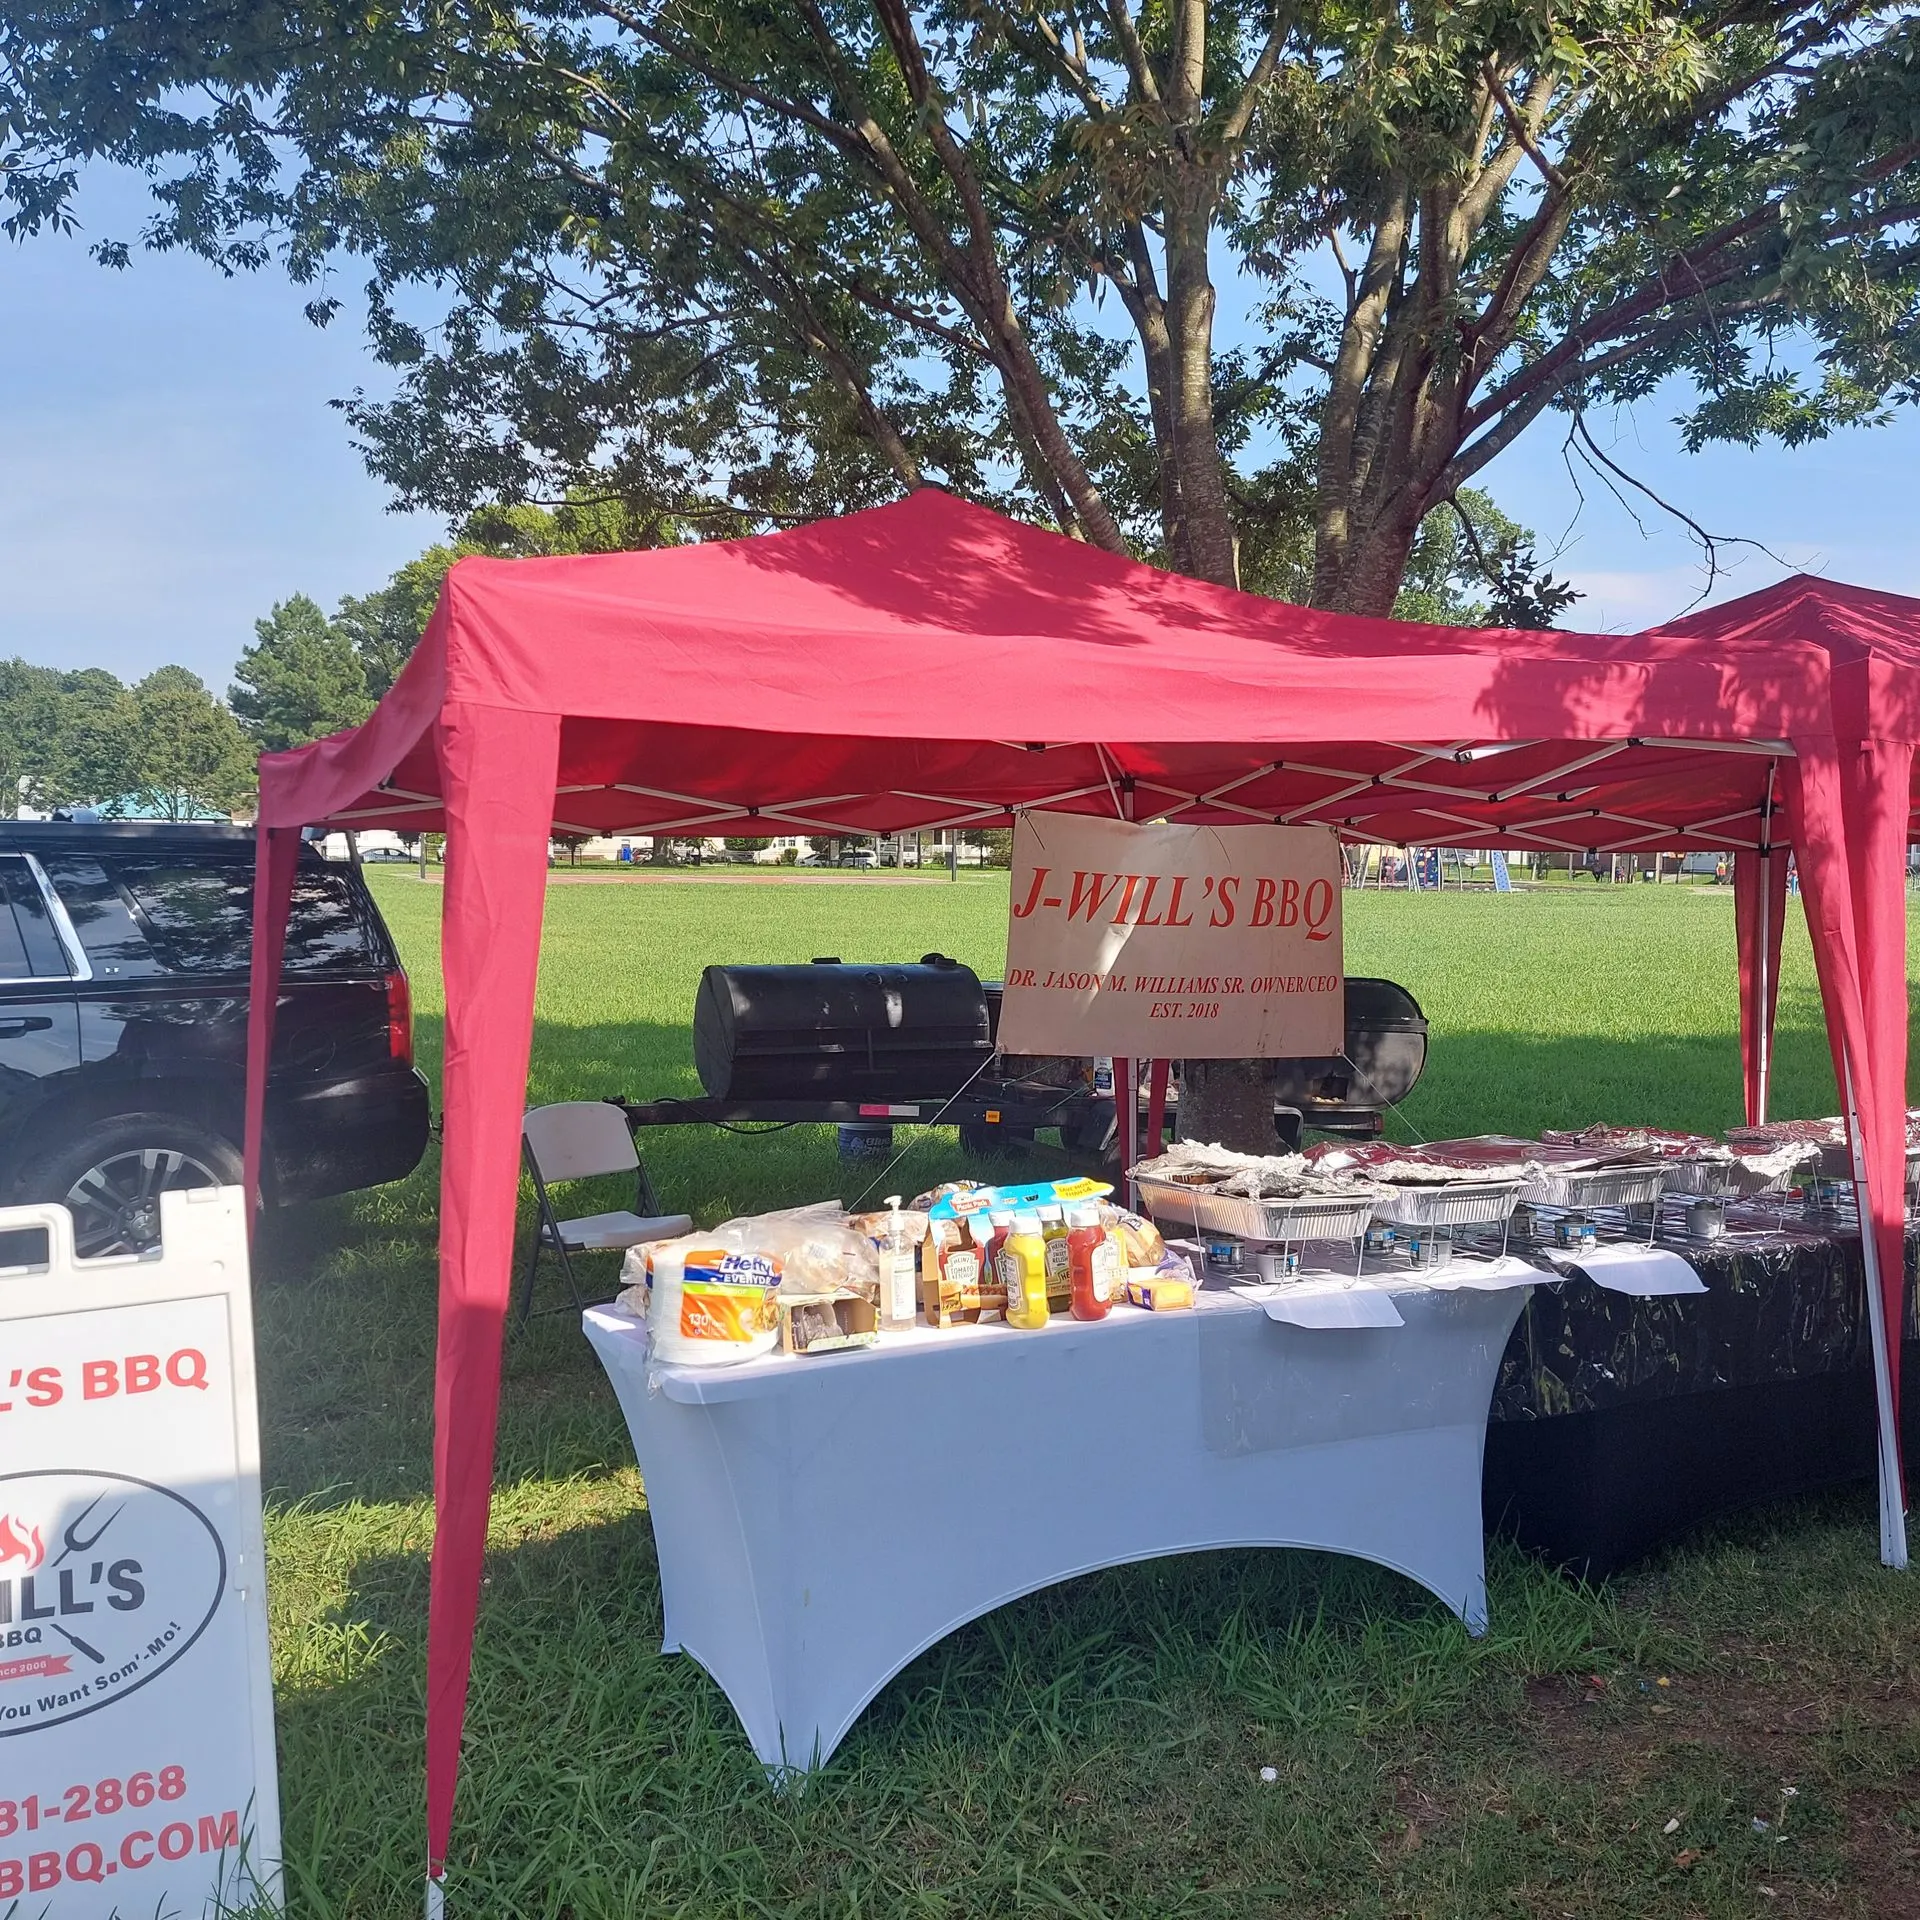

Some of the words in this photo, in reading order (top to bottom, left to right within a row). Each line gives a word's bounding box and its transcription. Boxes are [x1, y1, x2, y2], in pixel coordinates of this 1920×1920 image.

[1013, 867, 1240, 928] J-WILL'S
[1247, 878, 1334, 942] BBQ
[1008, 968, 1037, 988] DR.
[1043, 971, 1106, 991] JASON
[1107, 975, 1127, 992] M.
[1134, 975, 1219, 994] WILLIAMS
[1221, 976, 1245, 994] SR.
[1149, 1002, 1182, 1018] EST.
[1187, 1002, 1219, 1018] 2018
[82, 1347, 209, 1400] BBQ
[37, 1683, 91, 1712] Want
[0, 1810, 239, 1900] BBQ.COM
